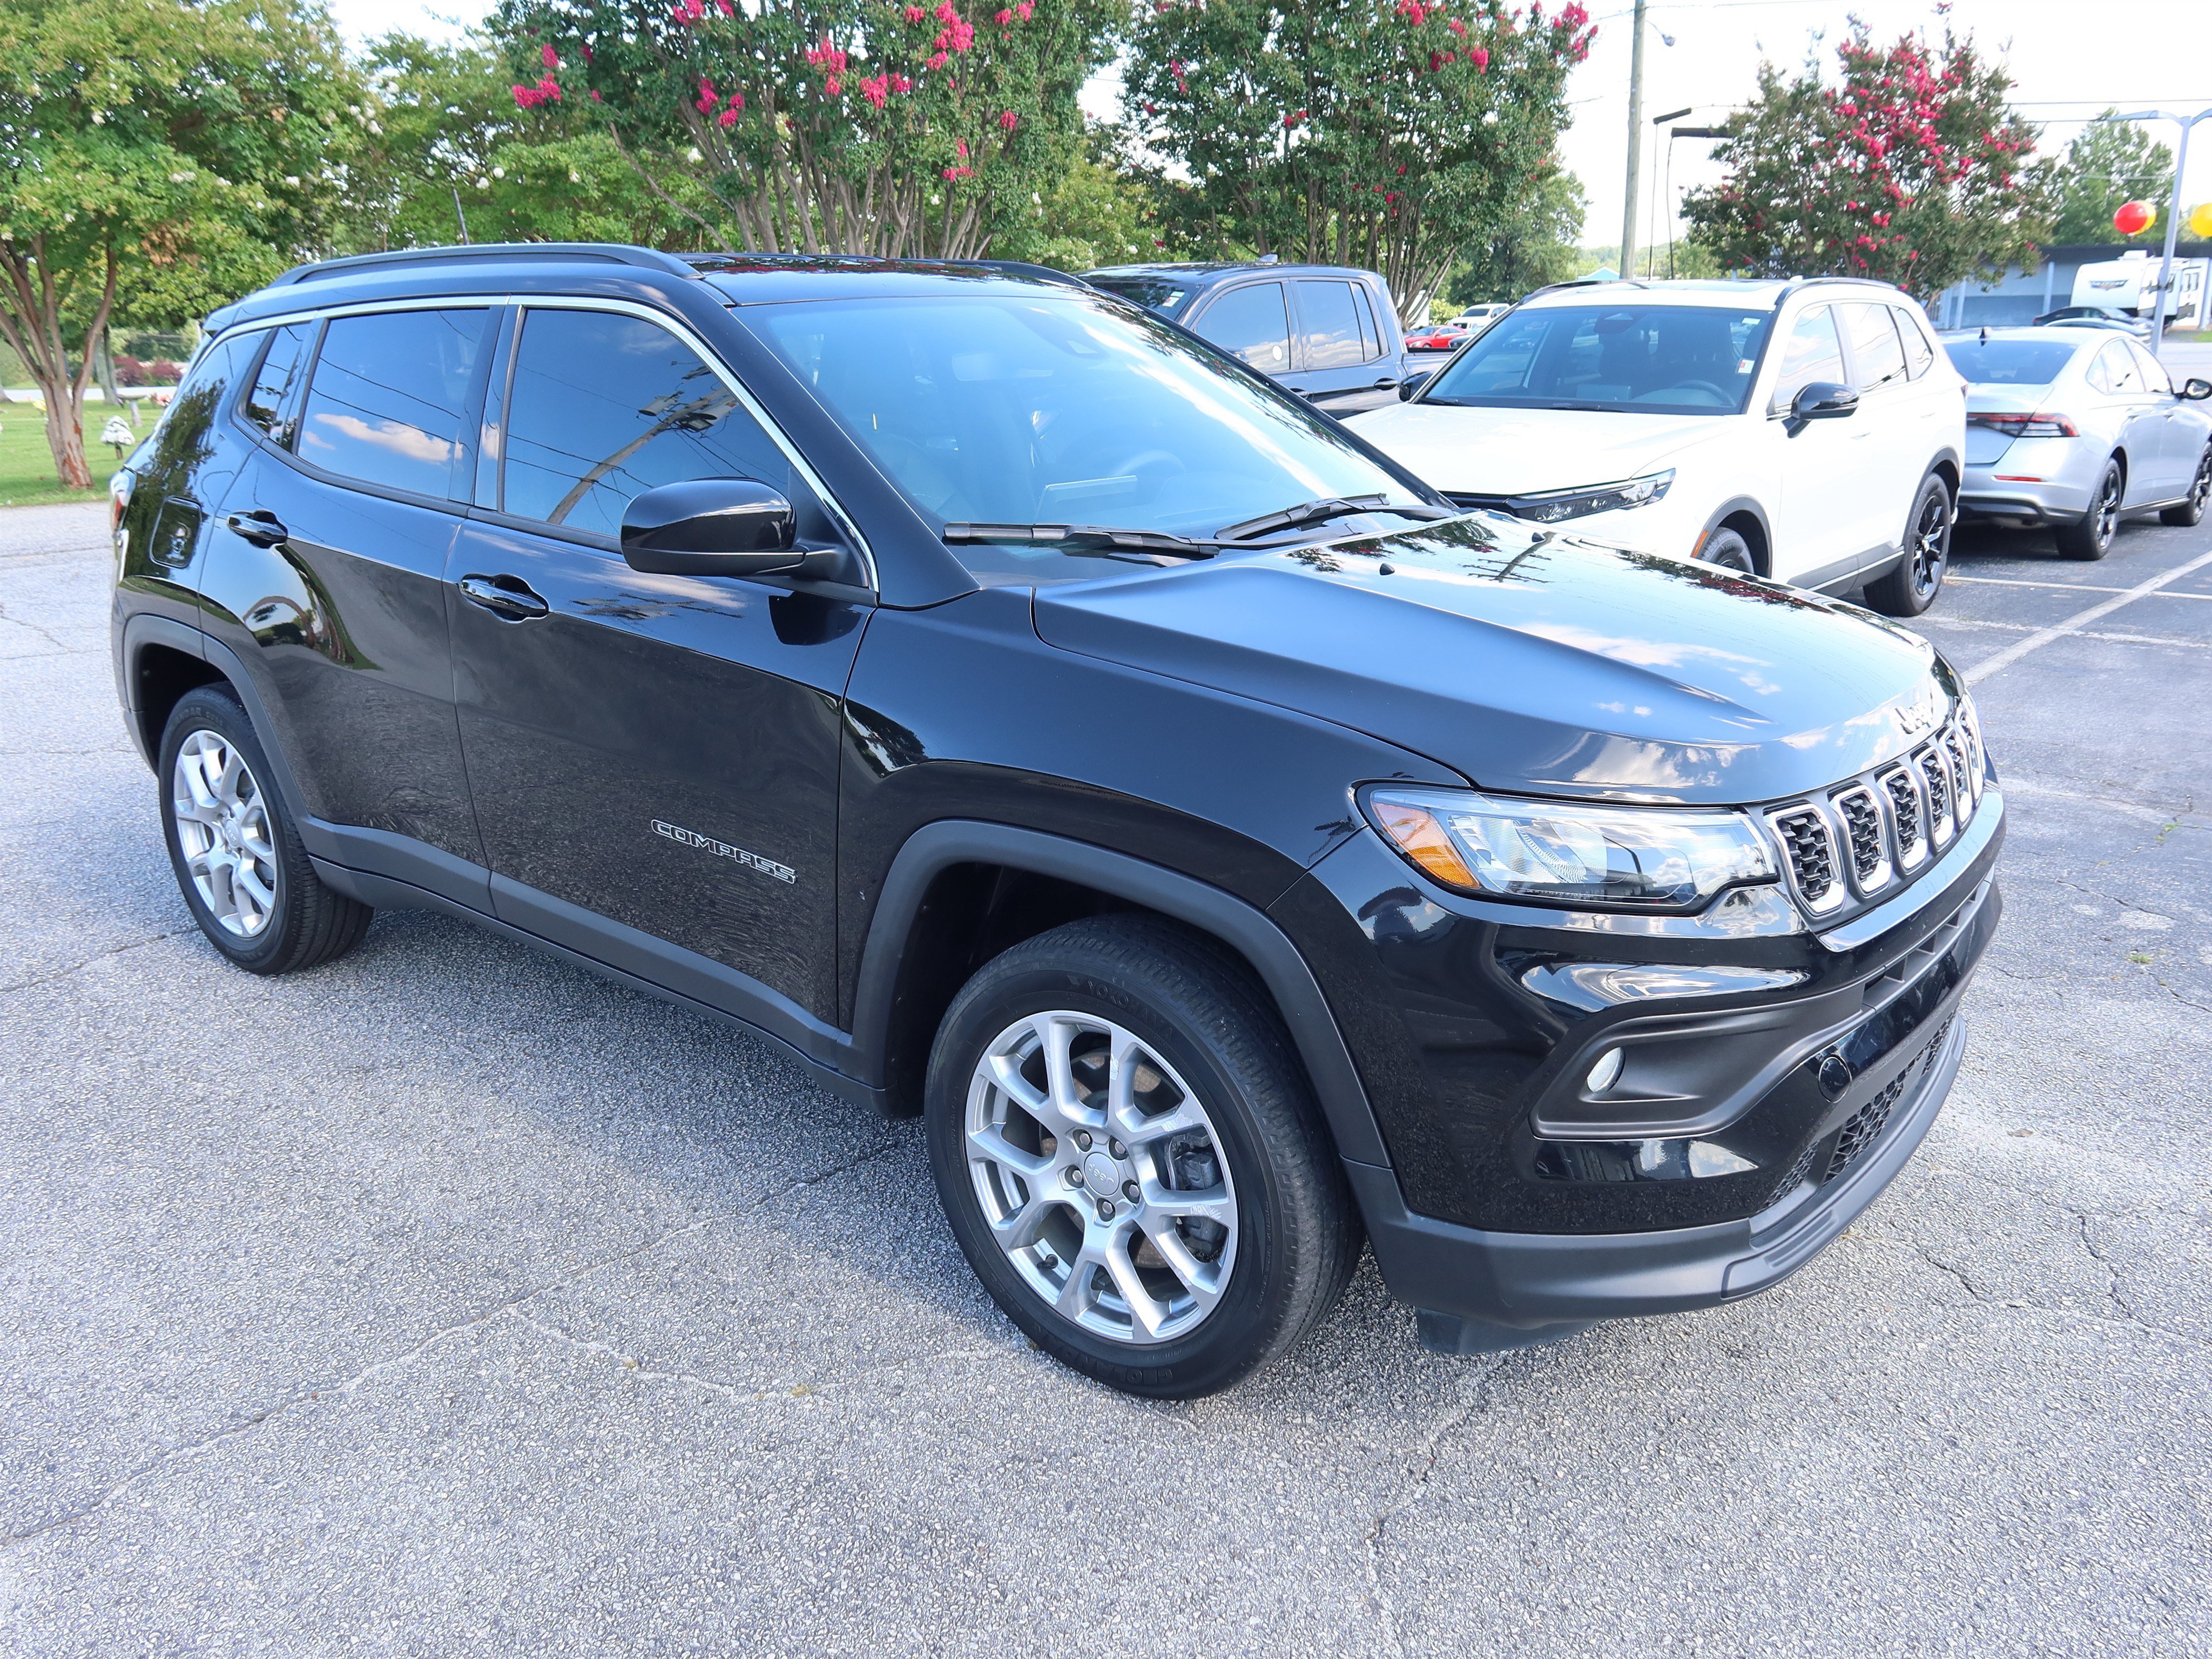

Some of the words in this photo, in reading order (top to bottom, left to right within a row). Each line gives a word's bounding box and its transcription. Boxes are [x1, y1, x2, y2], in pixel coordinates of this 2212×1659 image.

[1894, 702, 1934, 734] Jeep
[651, 819, 797, 885] COMPASS
[1088, 979, 1173, 1041] YOKOHAMA
[1088, 1163, 1115, 1188] Jeep
